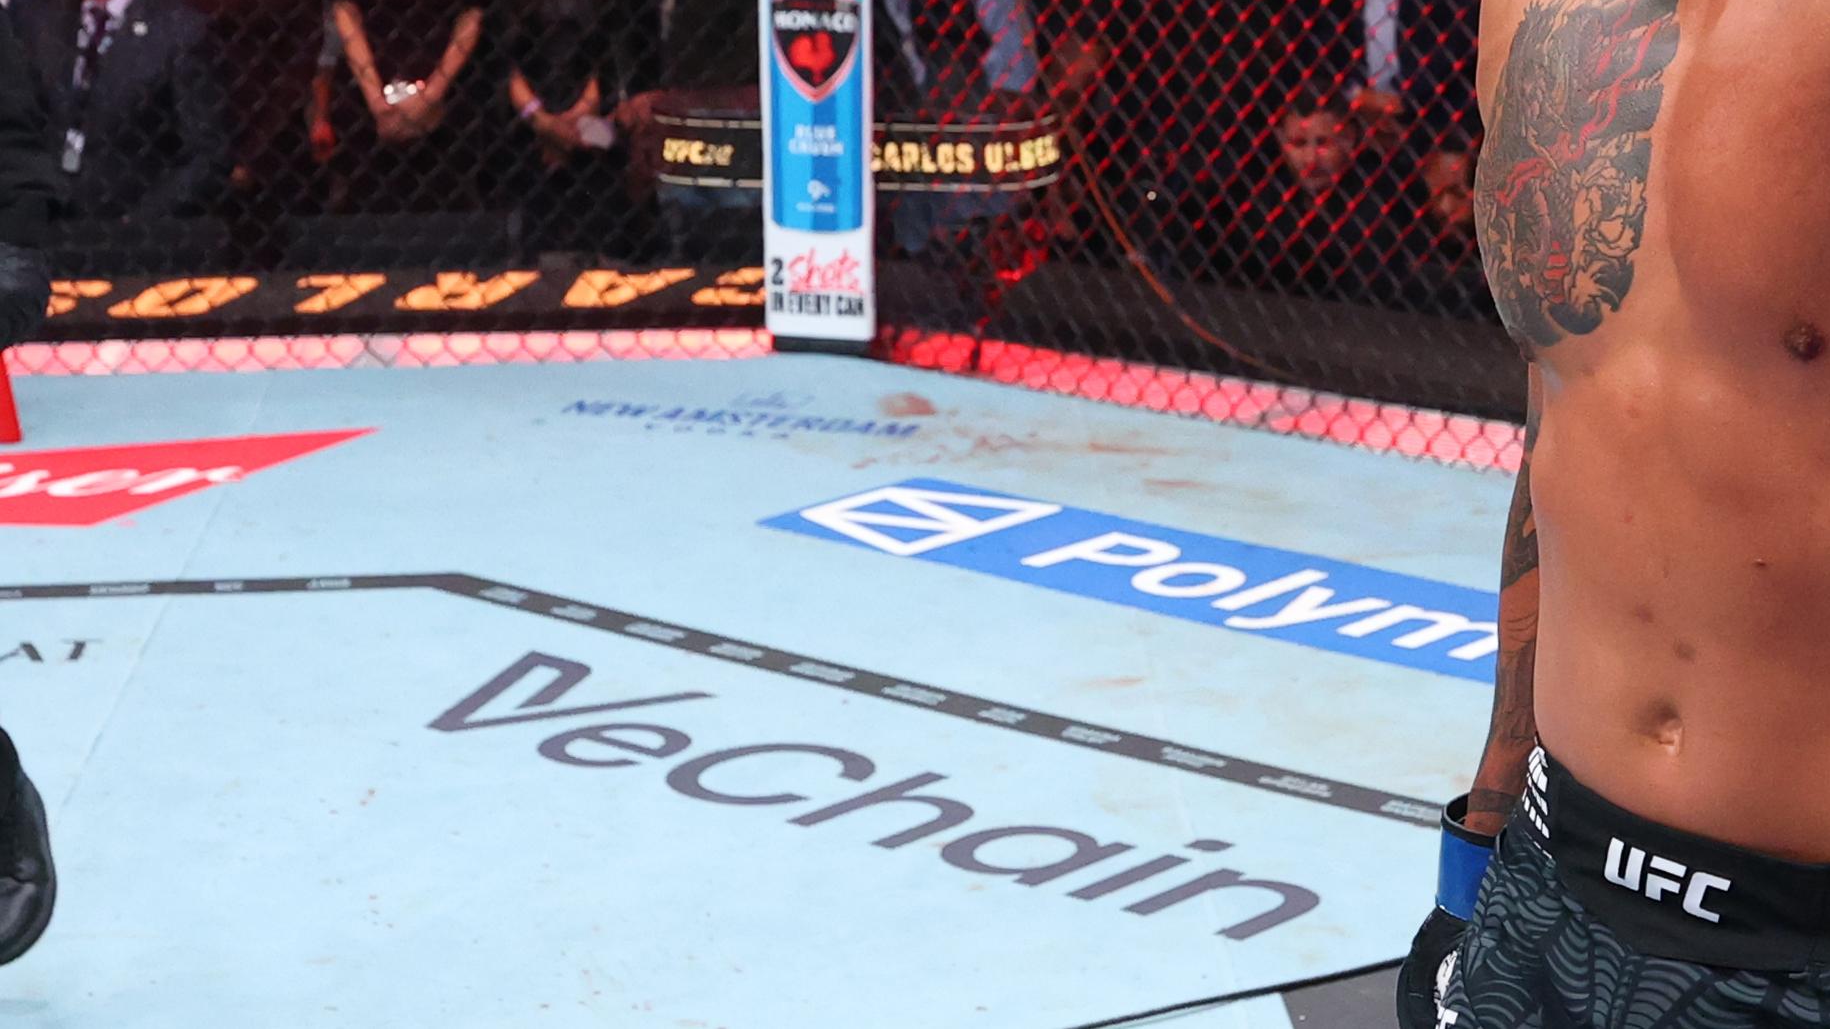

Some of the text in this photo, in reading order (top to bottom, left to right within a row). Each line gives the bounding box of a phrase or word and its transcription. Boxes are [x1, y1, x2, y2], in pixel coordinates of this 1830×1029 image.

[773, 10, 858, 33] MONACO
[770, 257, 784, 286] 2
[836, 295, 864, 316] CAN
[1021, 532, 1499, 660] Polym
[426, 650, 1320, 941] VeChain
[1603, 837, 1731, 923] UFC
